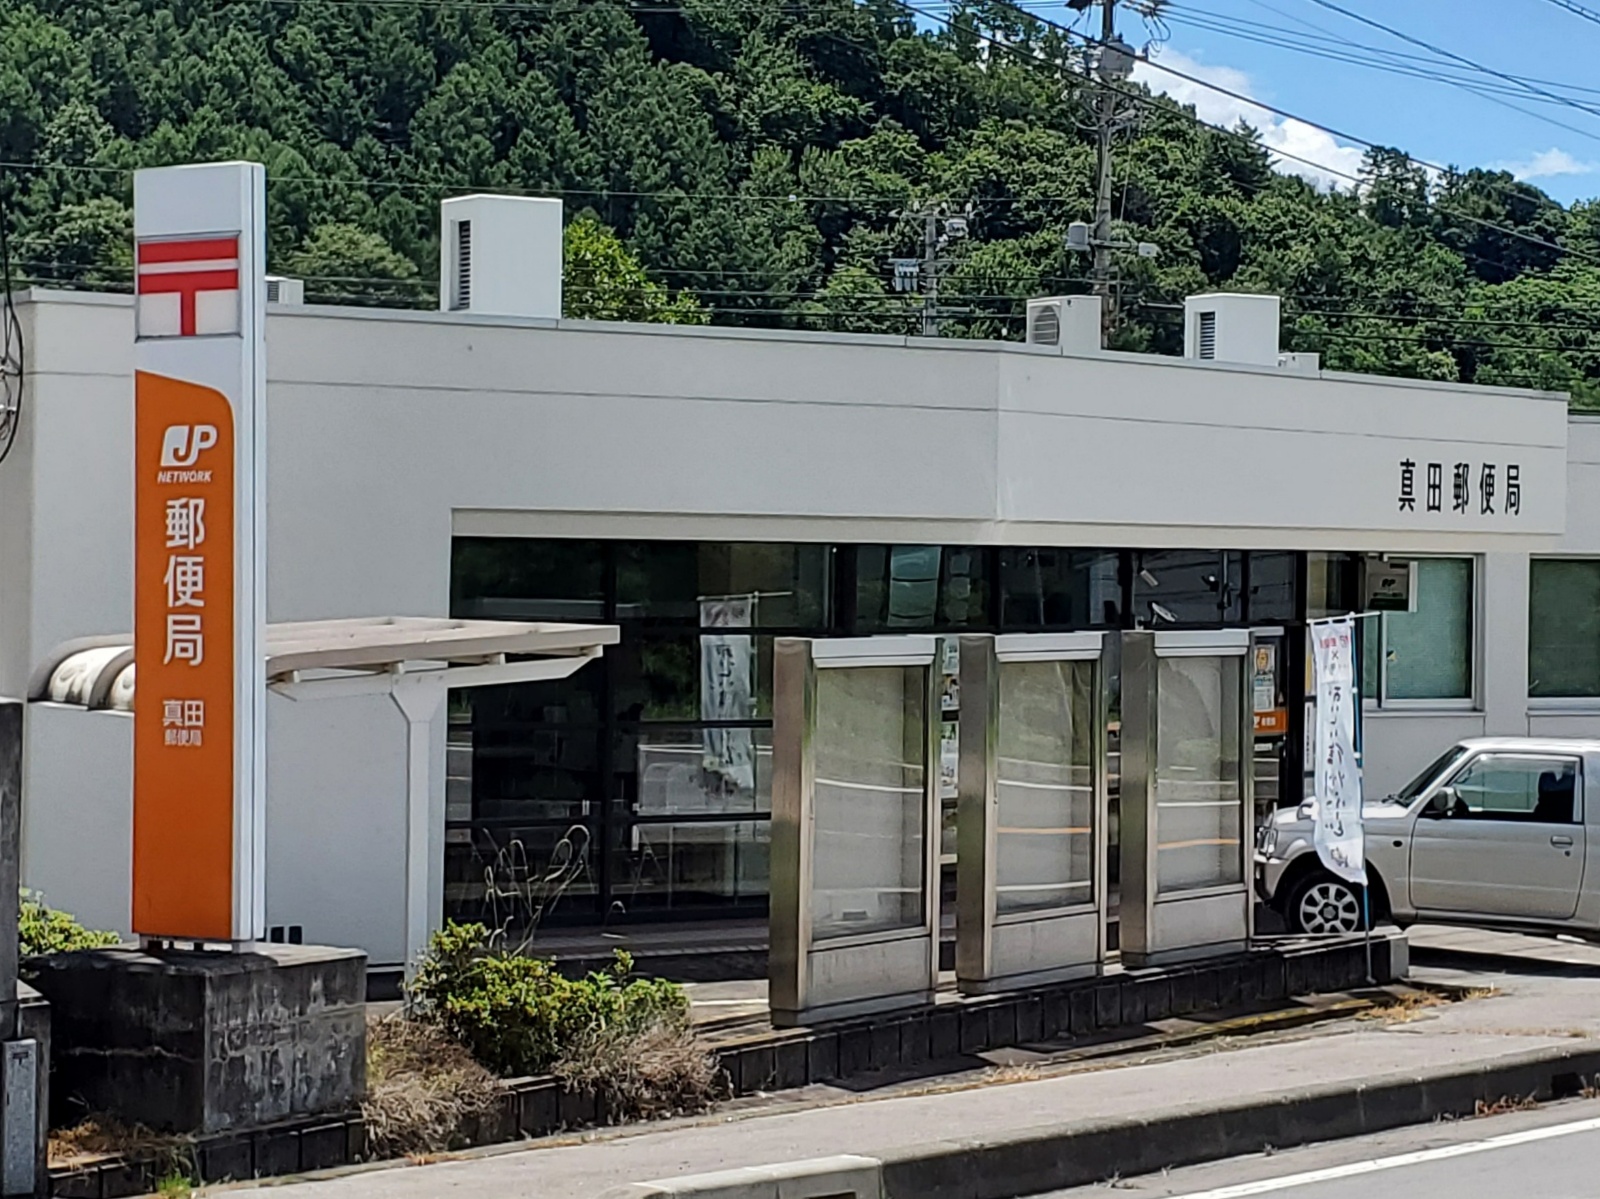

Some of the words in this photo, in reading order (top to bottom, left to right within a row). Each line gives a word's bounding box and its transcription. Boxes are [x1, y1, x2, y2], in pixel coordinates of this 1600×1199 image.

[160, 424, 218, 467] JP
[157, 470, 213, 484] NETWORK
[1398, 457, 1521, 517] 真田郵便局
[163, 497, 205, 667] 郵便局
[162, 700, 204, 728] 真田
[164, 729, 203, 747] 郵便局
